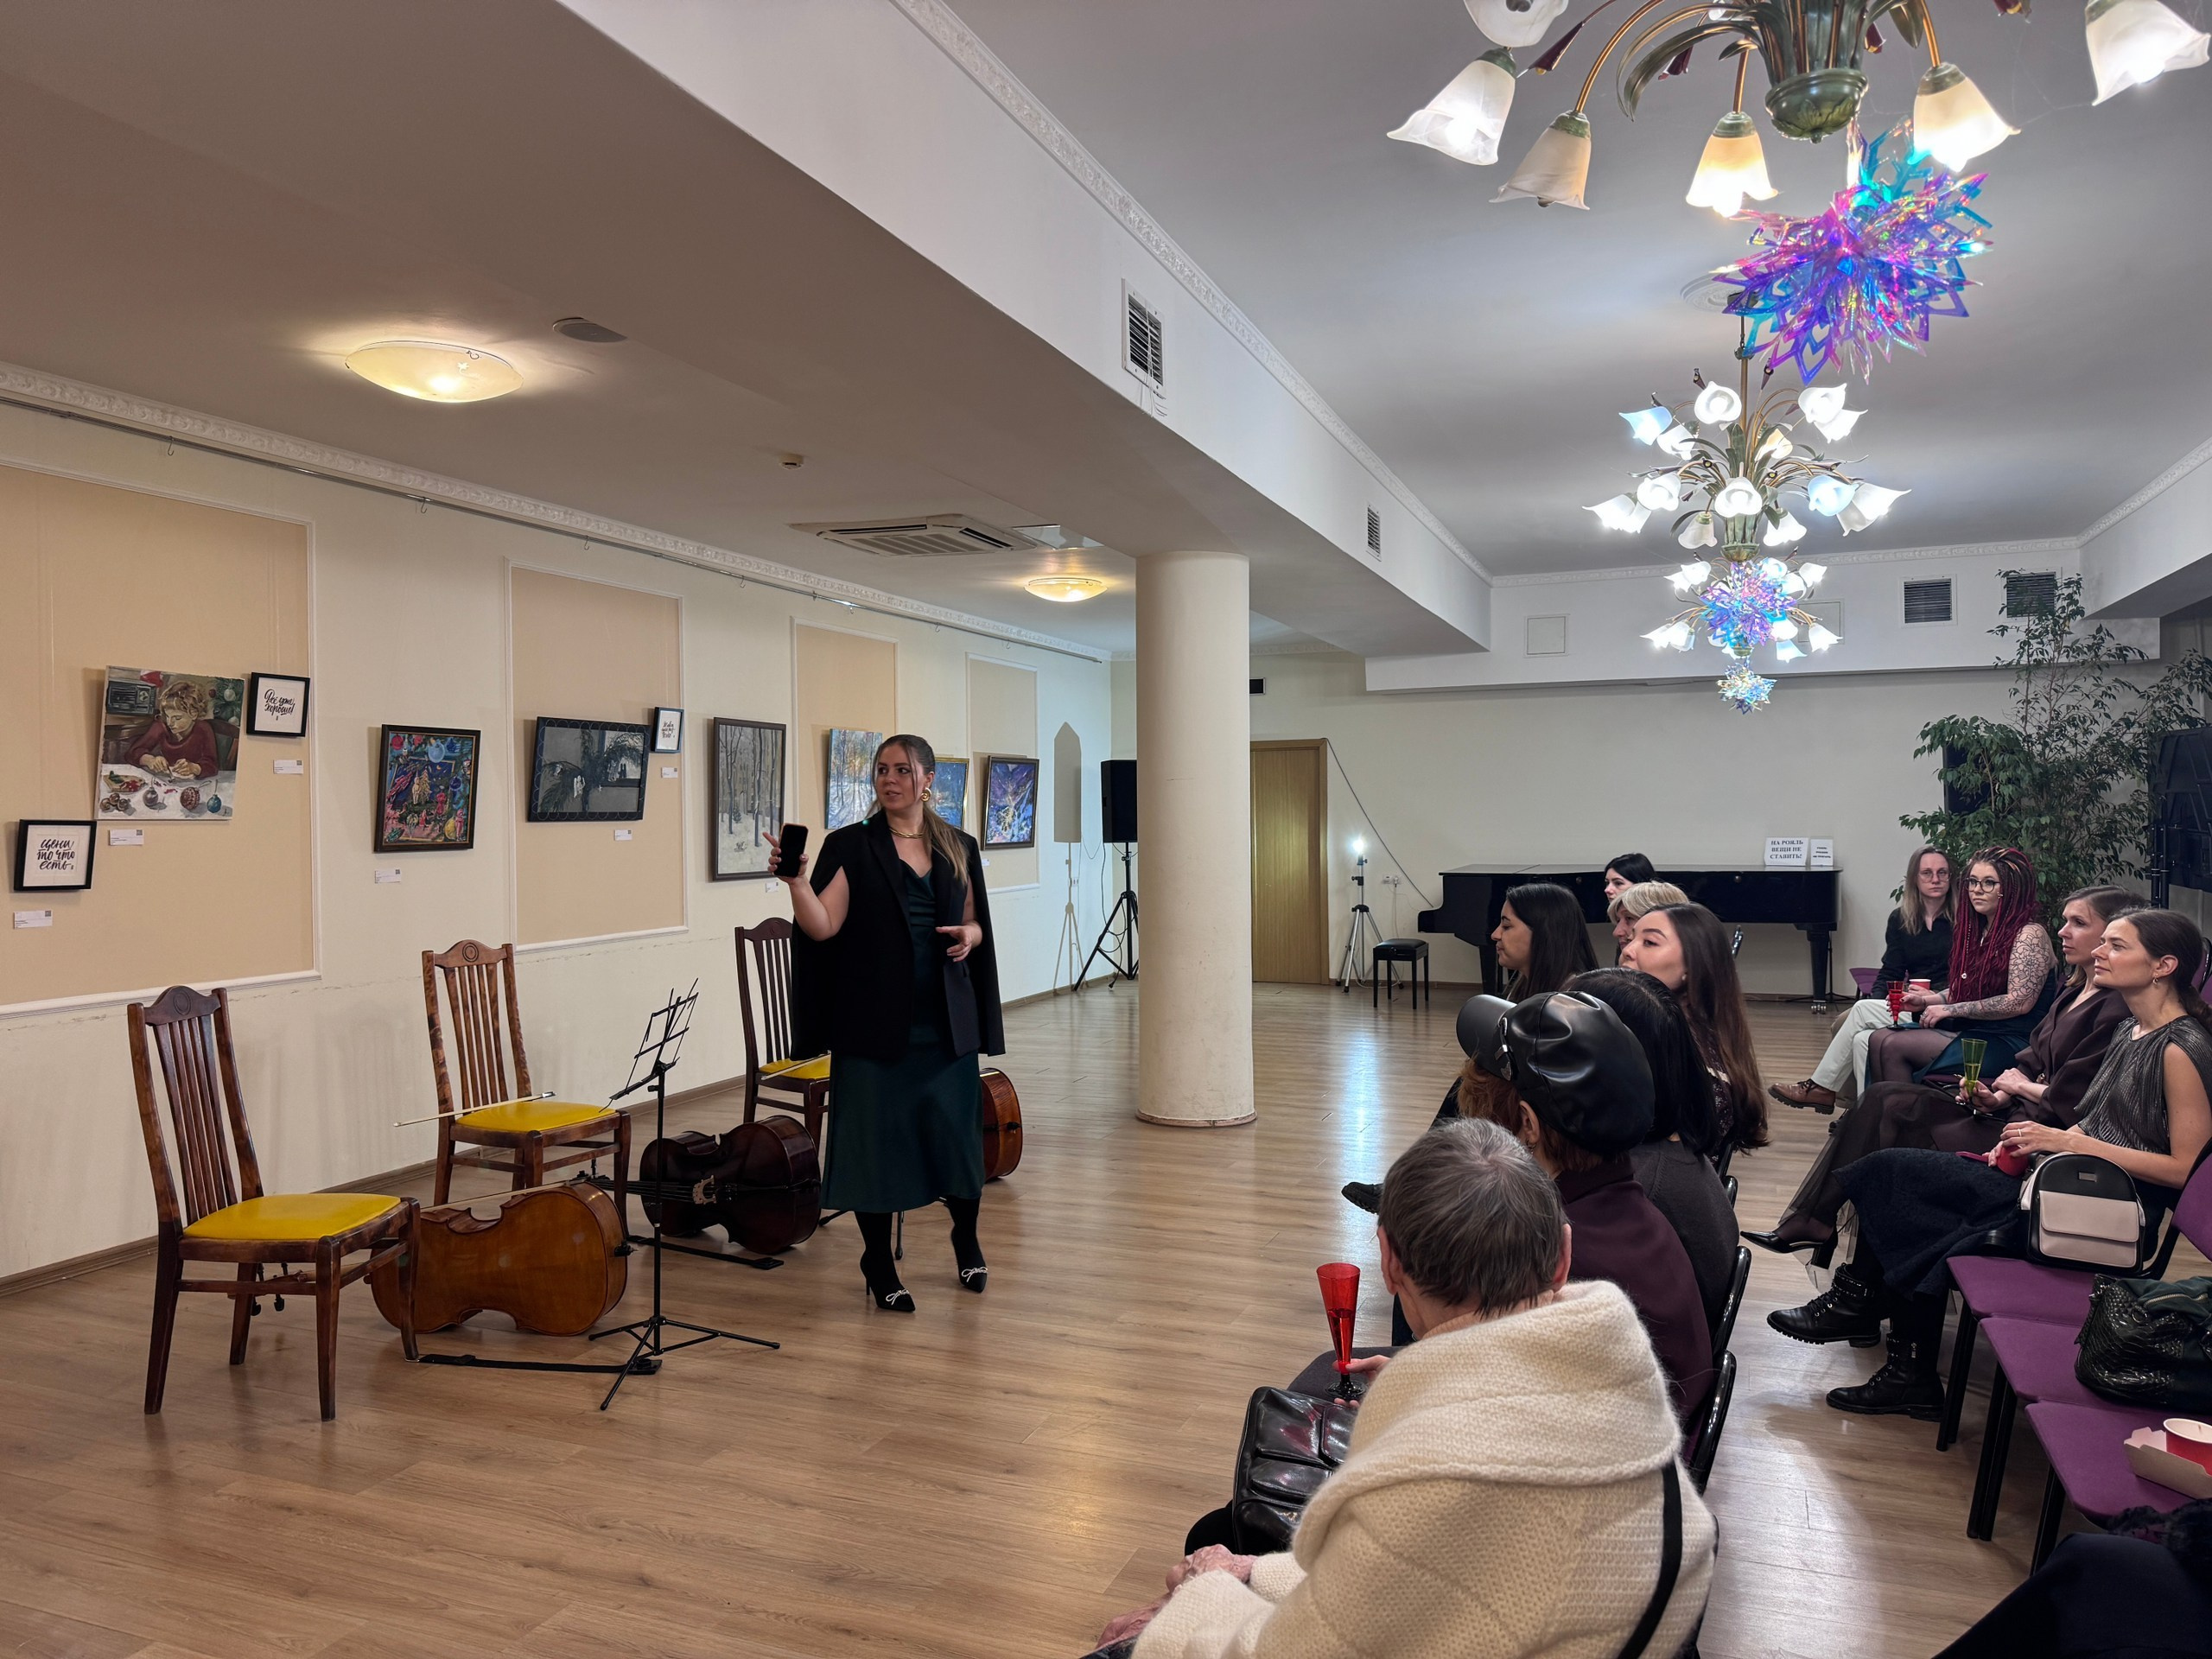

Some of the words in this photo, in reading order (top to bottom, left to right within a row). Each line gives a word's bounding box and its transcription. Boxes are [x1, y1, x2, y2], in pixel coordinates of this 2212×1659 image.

[36, 849, 54, 861] то
[55, 849, 75, 861] что
[39, 860, 72, 870] есть
